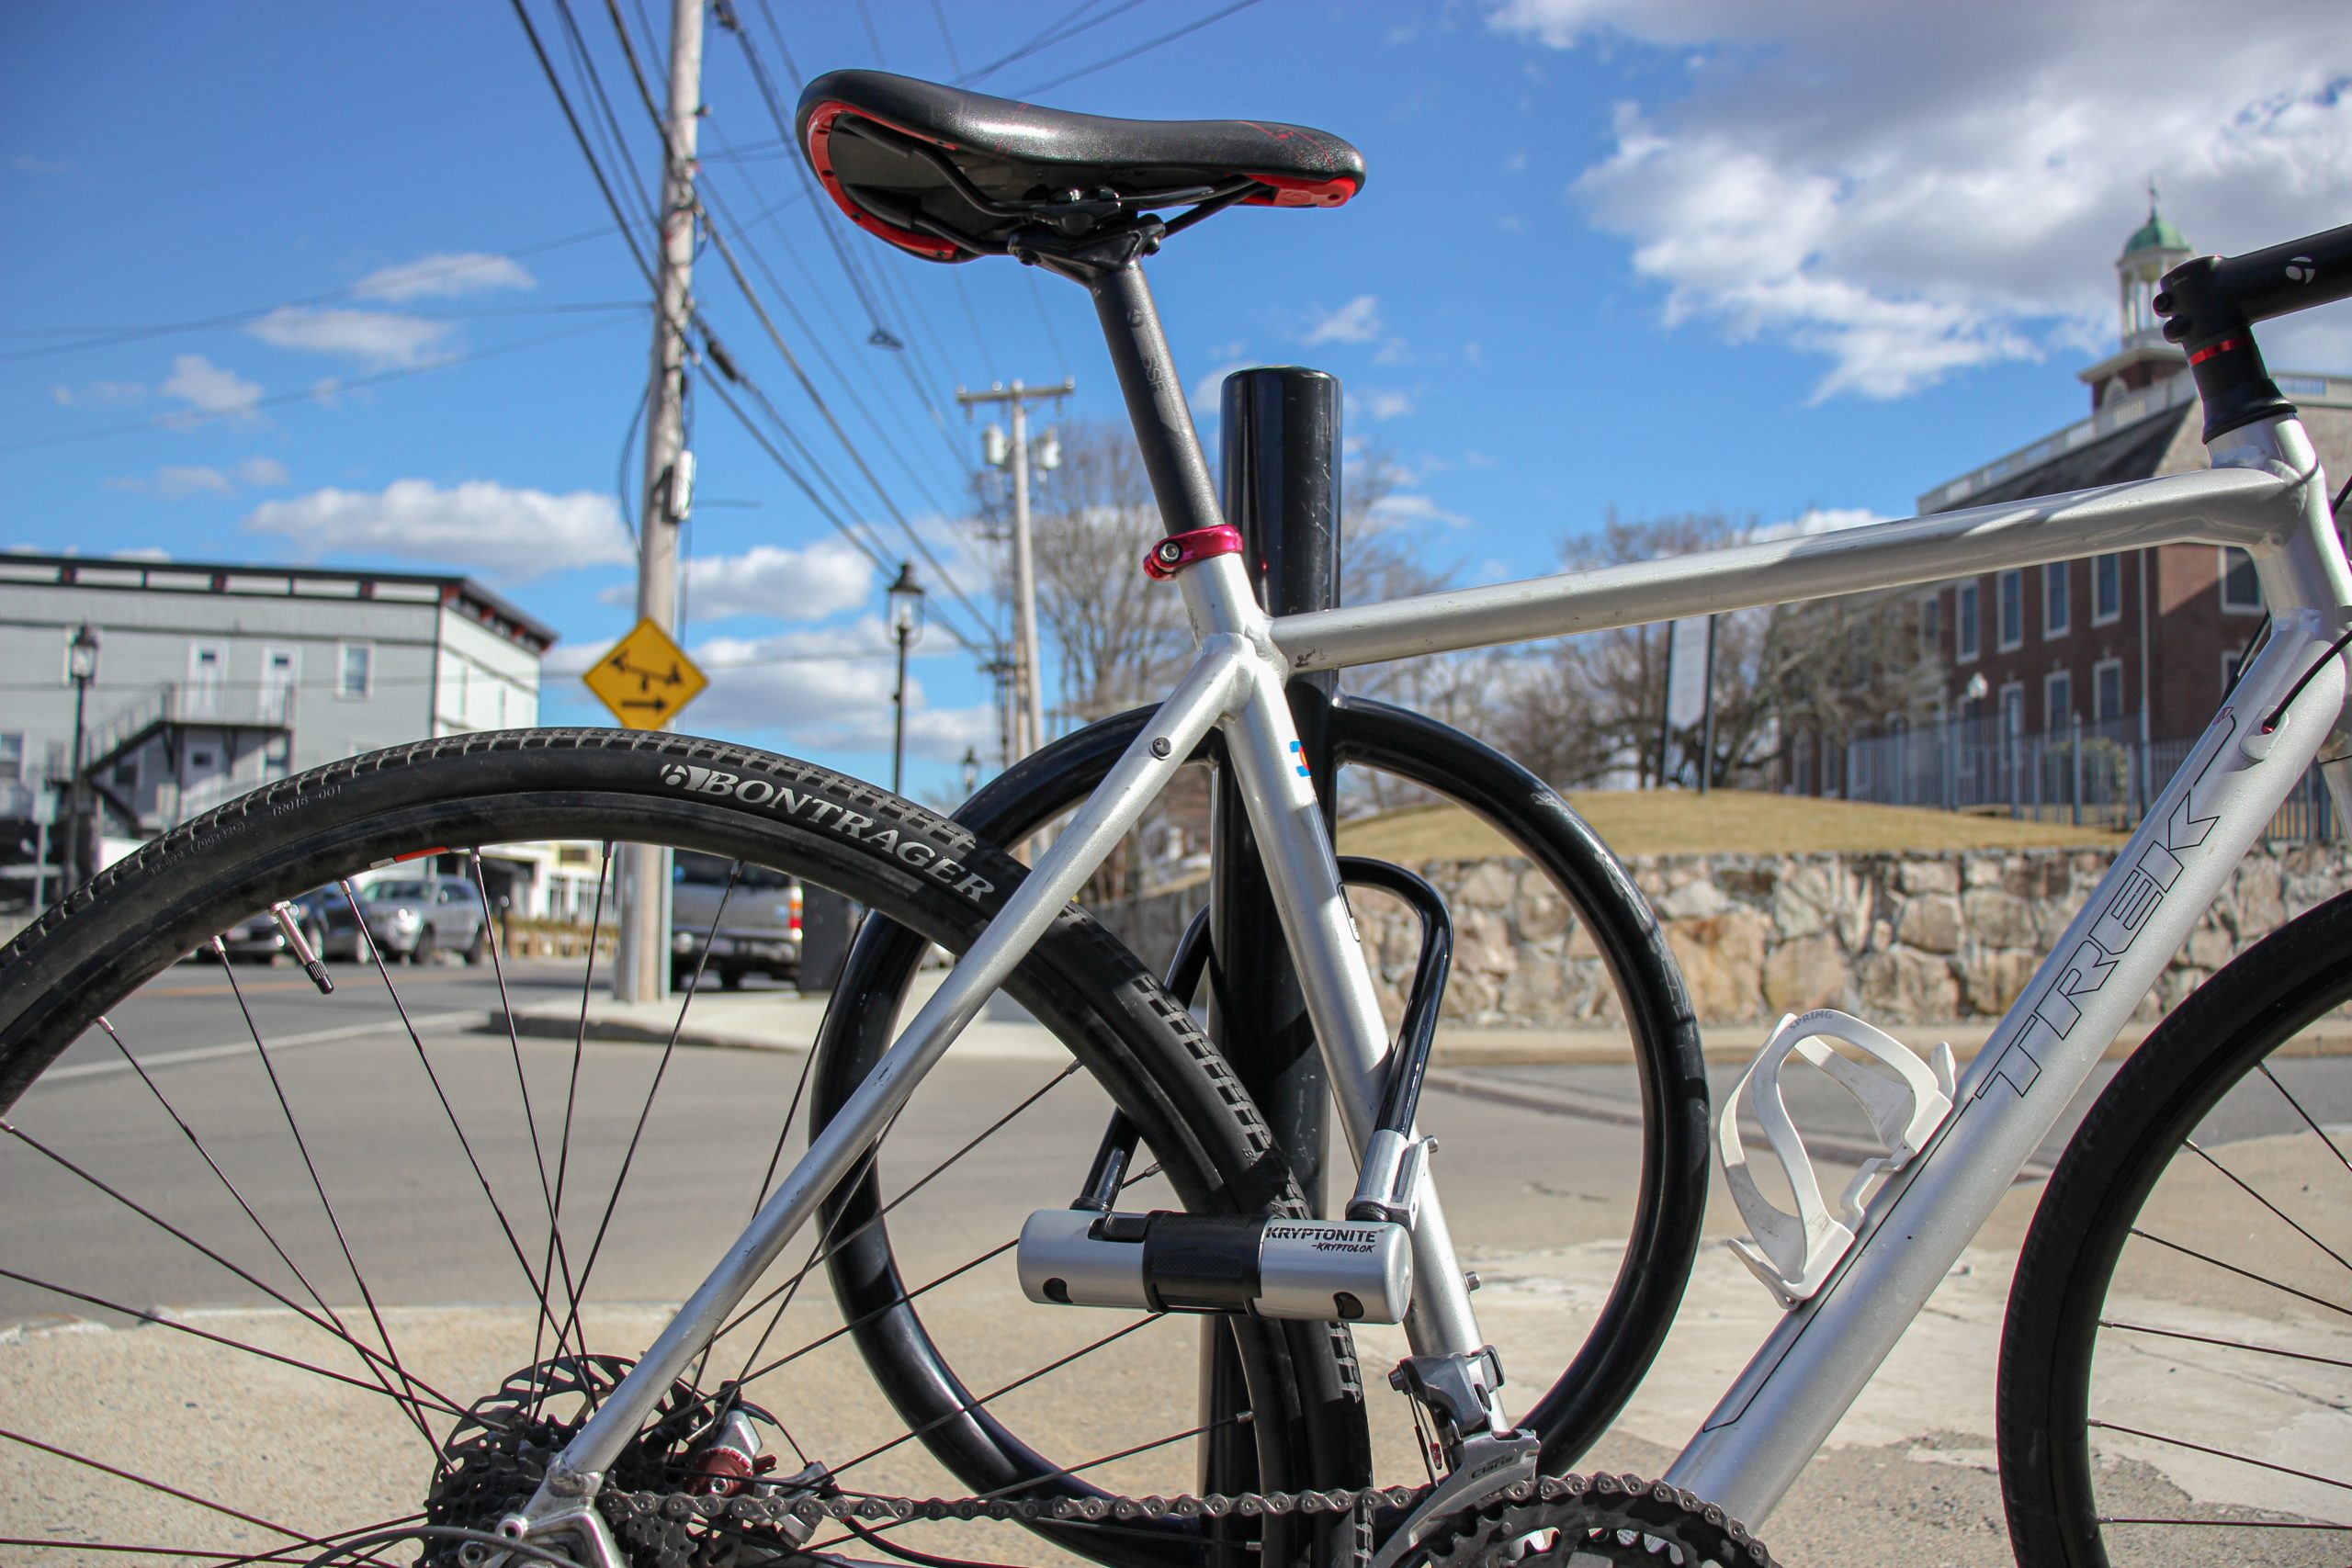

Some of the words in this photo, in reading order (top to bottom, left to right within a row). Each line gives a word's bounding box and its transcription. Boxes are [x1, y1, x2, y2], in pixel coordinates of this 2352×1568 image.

[700, 770, 995, 902] BONTRAGER
[1974, 789, 2221, 1099] TREK
[1789, 1010, 1833, 1030] SPRING
[1266, 1227, 1376, 1243] KRYPTONITE
